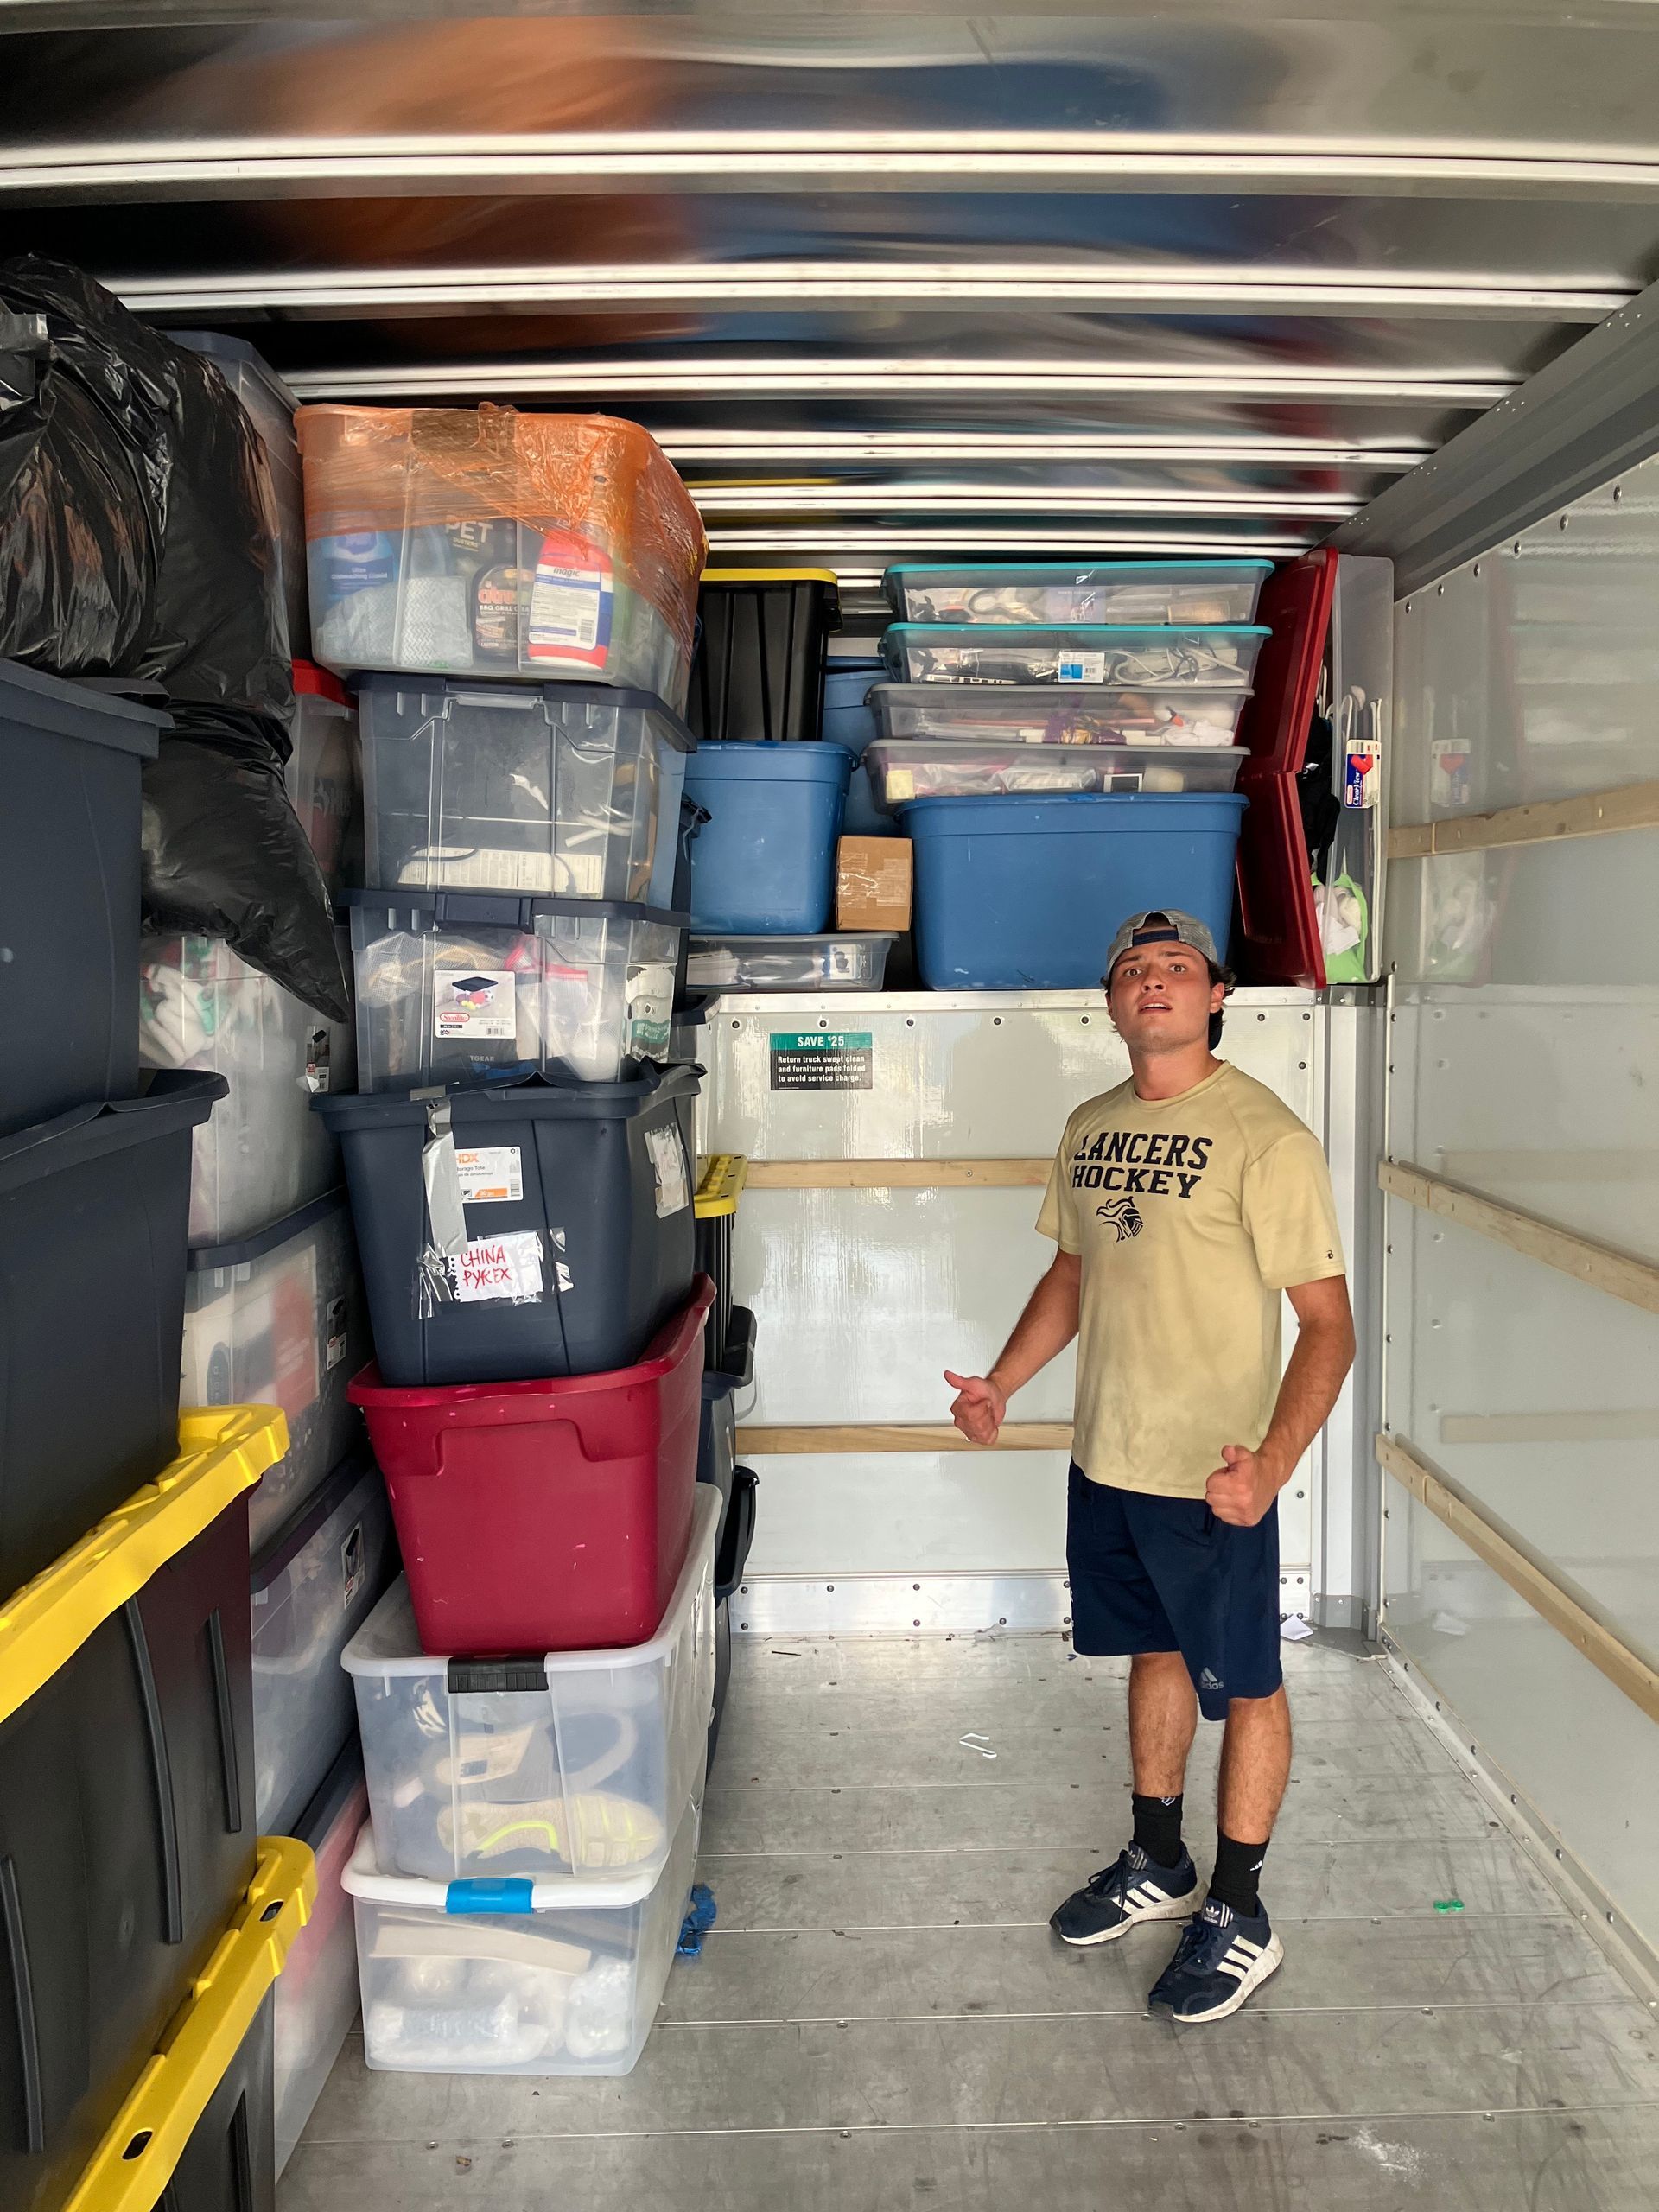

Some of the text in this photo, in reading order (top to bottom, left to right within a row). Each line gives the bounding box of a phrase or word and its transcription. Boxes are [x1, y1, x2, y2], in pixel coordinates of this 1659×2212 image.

[446, 515, 493, 543] PET
[553, 566, 580, 577] magic
[797, 1035, 844, 1047] SAVE $25
[823, 1055, 844, 1065] swept
[792, 1065, 823, 1073] furniture
[824, 1065, 842, 1075] pads
[843, 1064, 866, 1072] folded
[778, 1073, 862, 1083] to avoid service charge.
[1074, 1131, 1213, 1170] LANCERS
[1072, 1164, 1202, 1199] HOCKEY
[461, 1244, 506, 1268] CHINA
